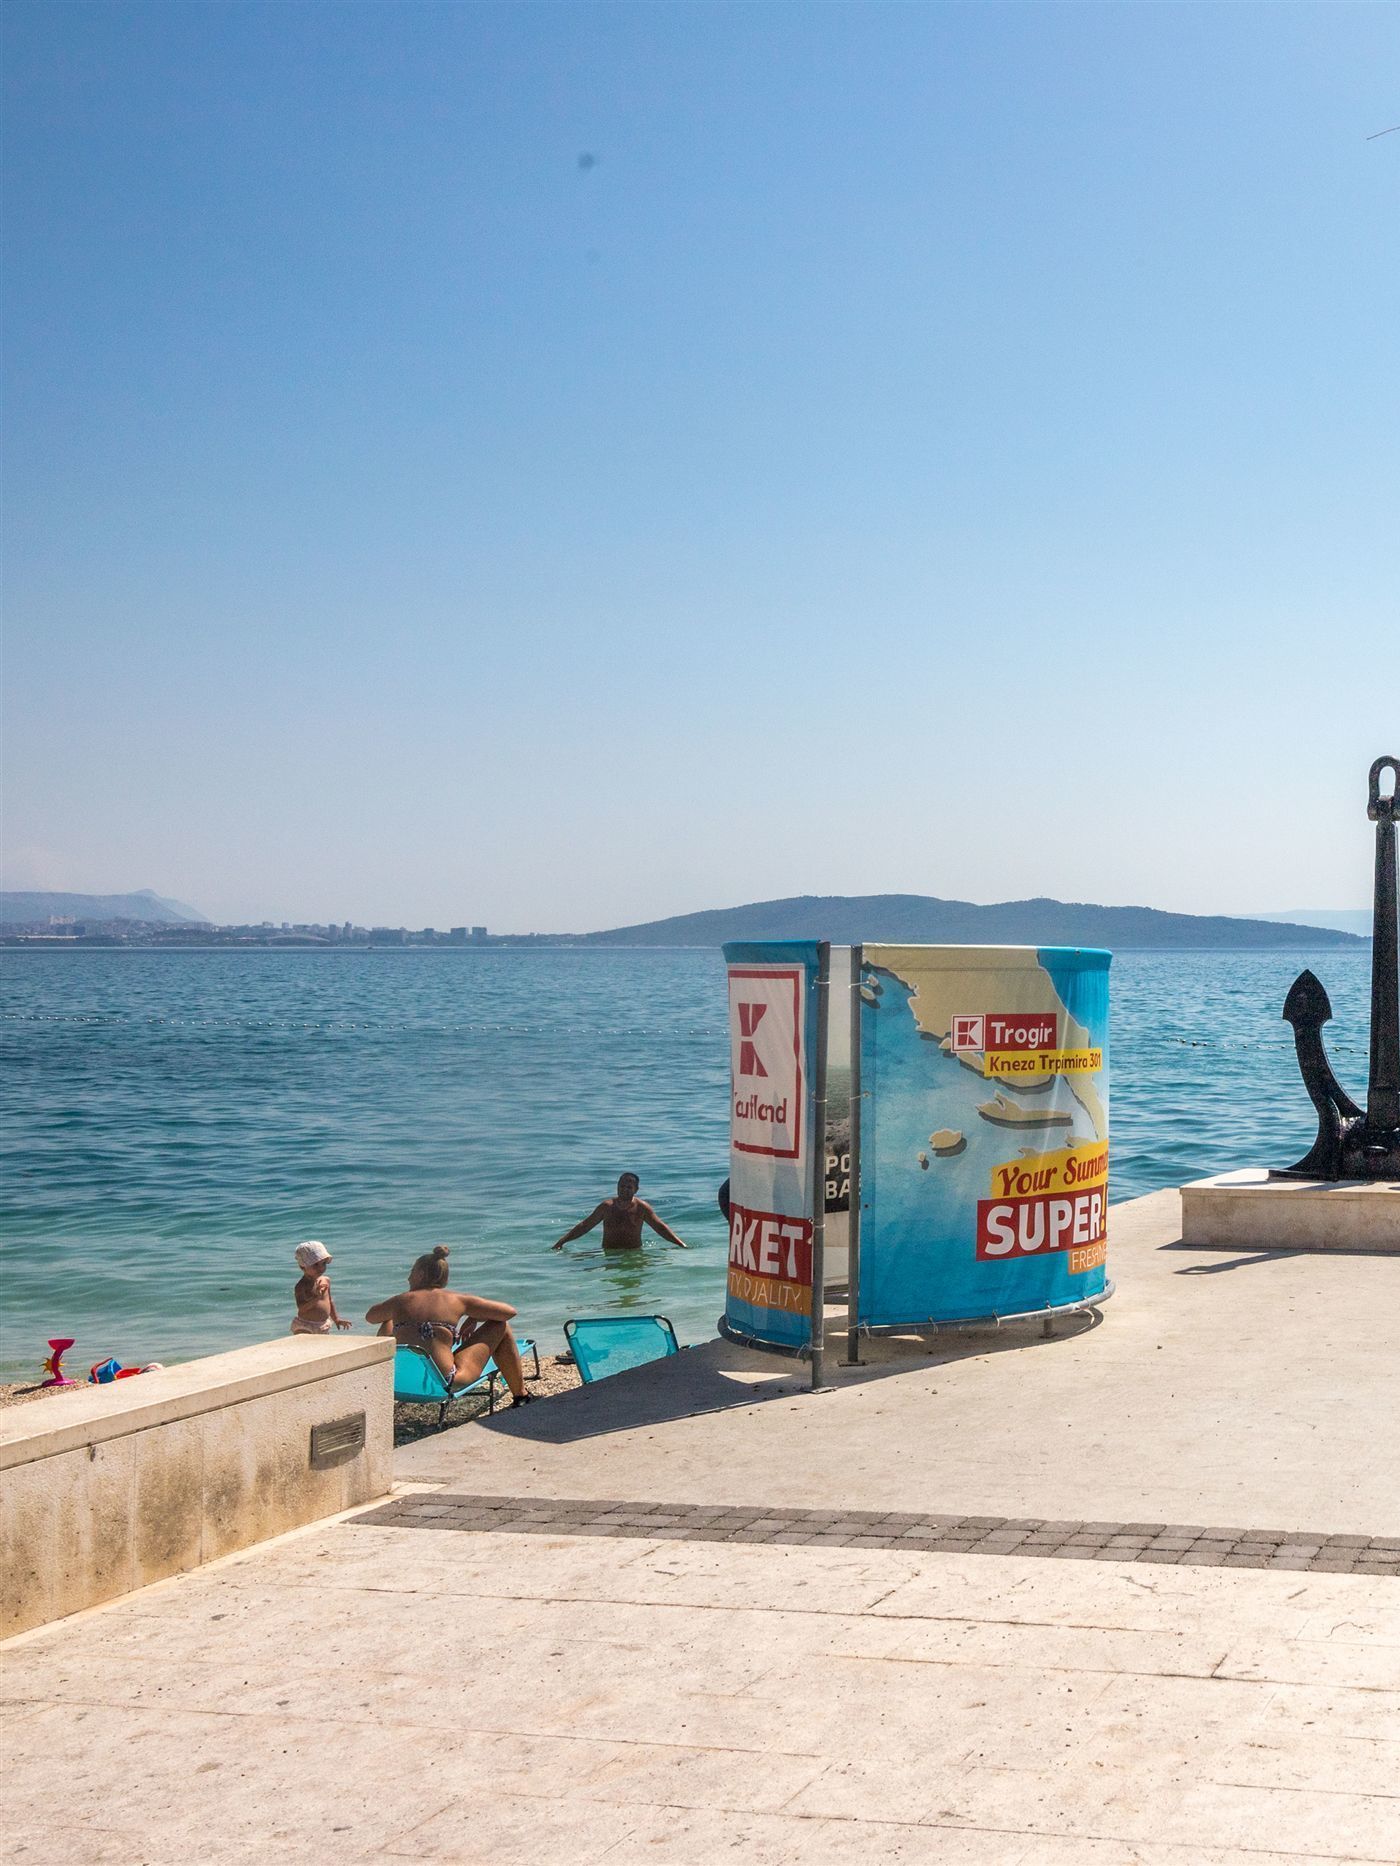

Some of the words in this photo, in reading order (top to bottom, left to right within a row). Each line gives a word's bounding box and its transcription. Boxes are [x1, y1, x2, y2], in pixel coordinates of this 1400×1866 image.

[991, 1022, 1053, 1049] Trogir
[990, 1056, 1035, 1072] Kneza
[1039, 1053, 1088, 1073] Trpimira
[1089, 1053, 1101, 1068] 301
[735, 1092, 788, 1124] aufland
[998, 1166, 1058, 1196] Your
[985, 1185, 1106, 1256] SUPER!
[730, 1212, 803, 1278] RKET
